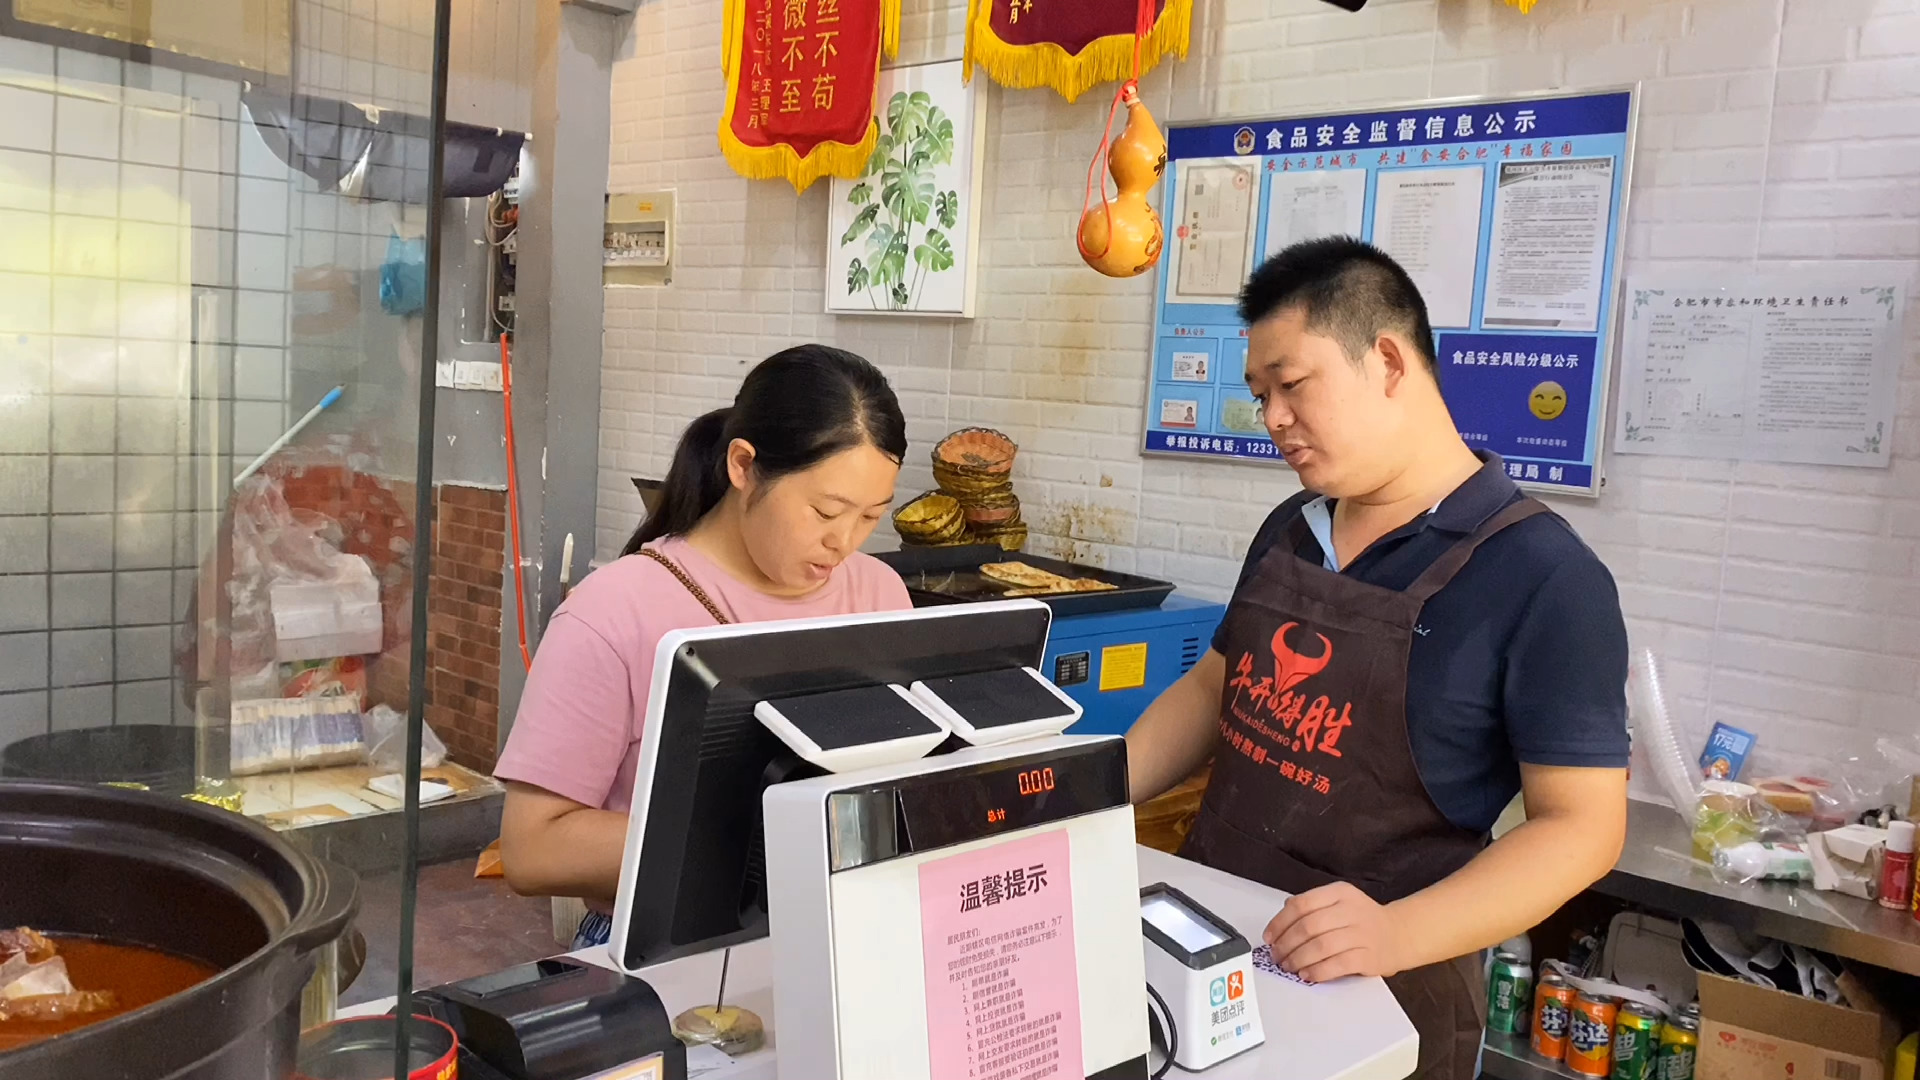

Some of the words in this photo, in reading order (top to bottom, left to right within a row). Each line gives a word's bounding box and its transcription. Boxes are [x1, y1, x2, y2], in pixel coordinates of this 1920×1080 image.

[1265, 109, 1537, 150] 食品安全监督信息公示
[1264, 152, 1358, 172] 安全示范城市
[1452, 350, 1579, 369] 食品安全风险分级公示
[1549, 466, 1564, 481] 制
[1018, 767, 1055, 795] 0.00
[959, 862, 1048, 914] 温馨提示
[1211, 1000, 1246, 1027] 美团点评
[1570, 1019, 1609, 1044] 芬达
